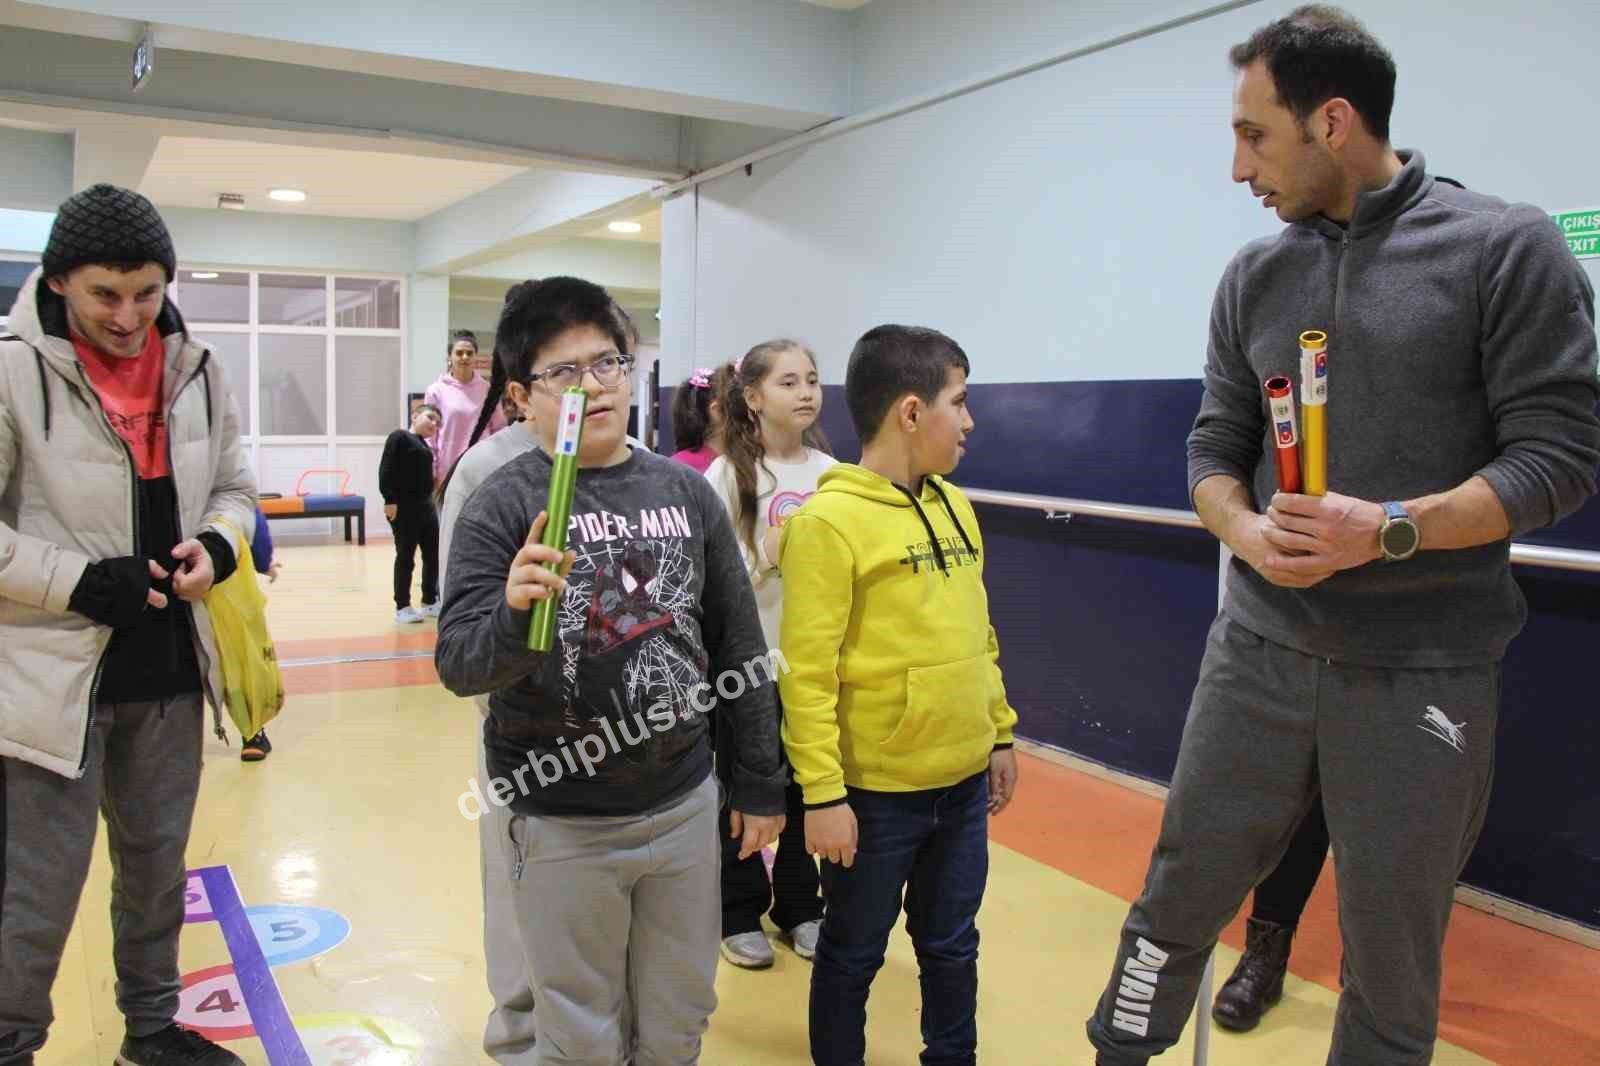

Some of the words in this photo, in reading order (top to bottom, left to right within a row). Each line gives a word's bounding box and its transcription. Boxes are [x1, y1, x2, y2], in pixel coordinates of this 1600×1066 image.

[565, 506, 692, 543] PIDER-MAN
[269, 920, 306, 942] 5
[195, 988, 240, 1013] 4
